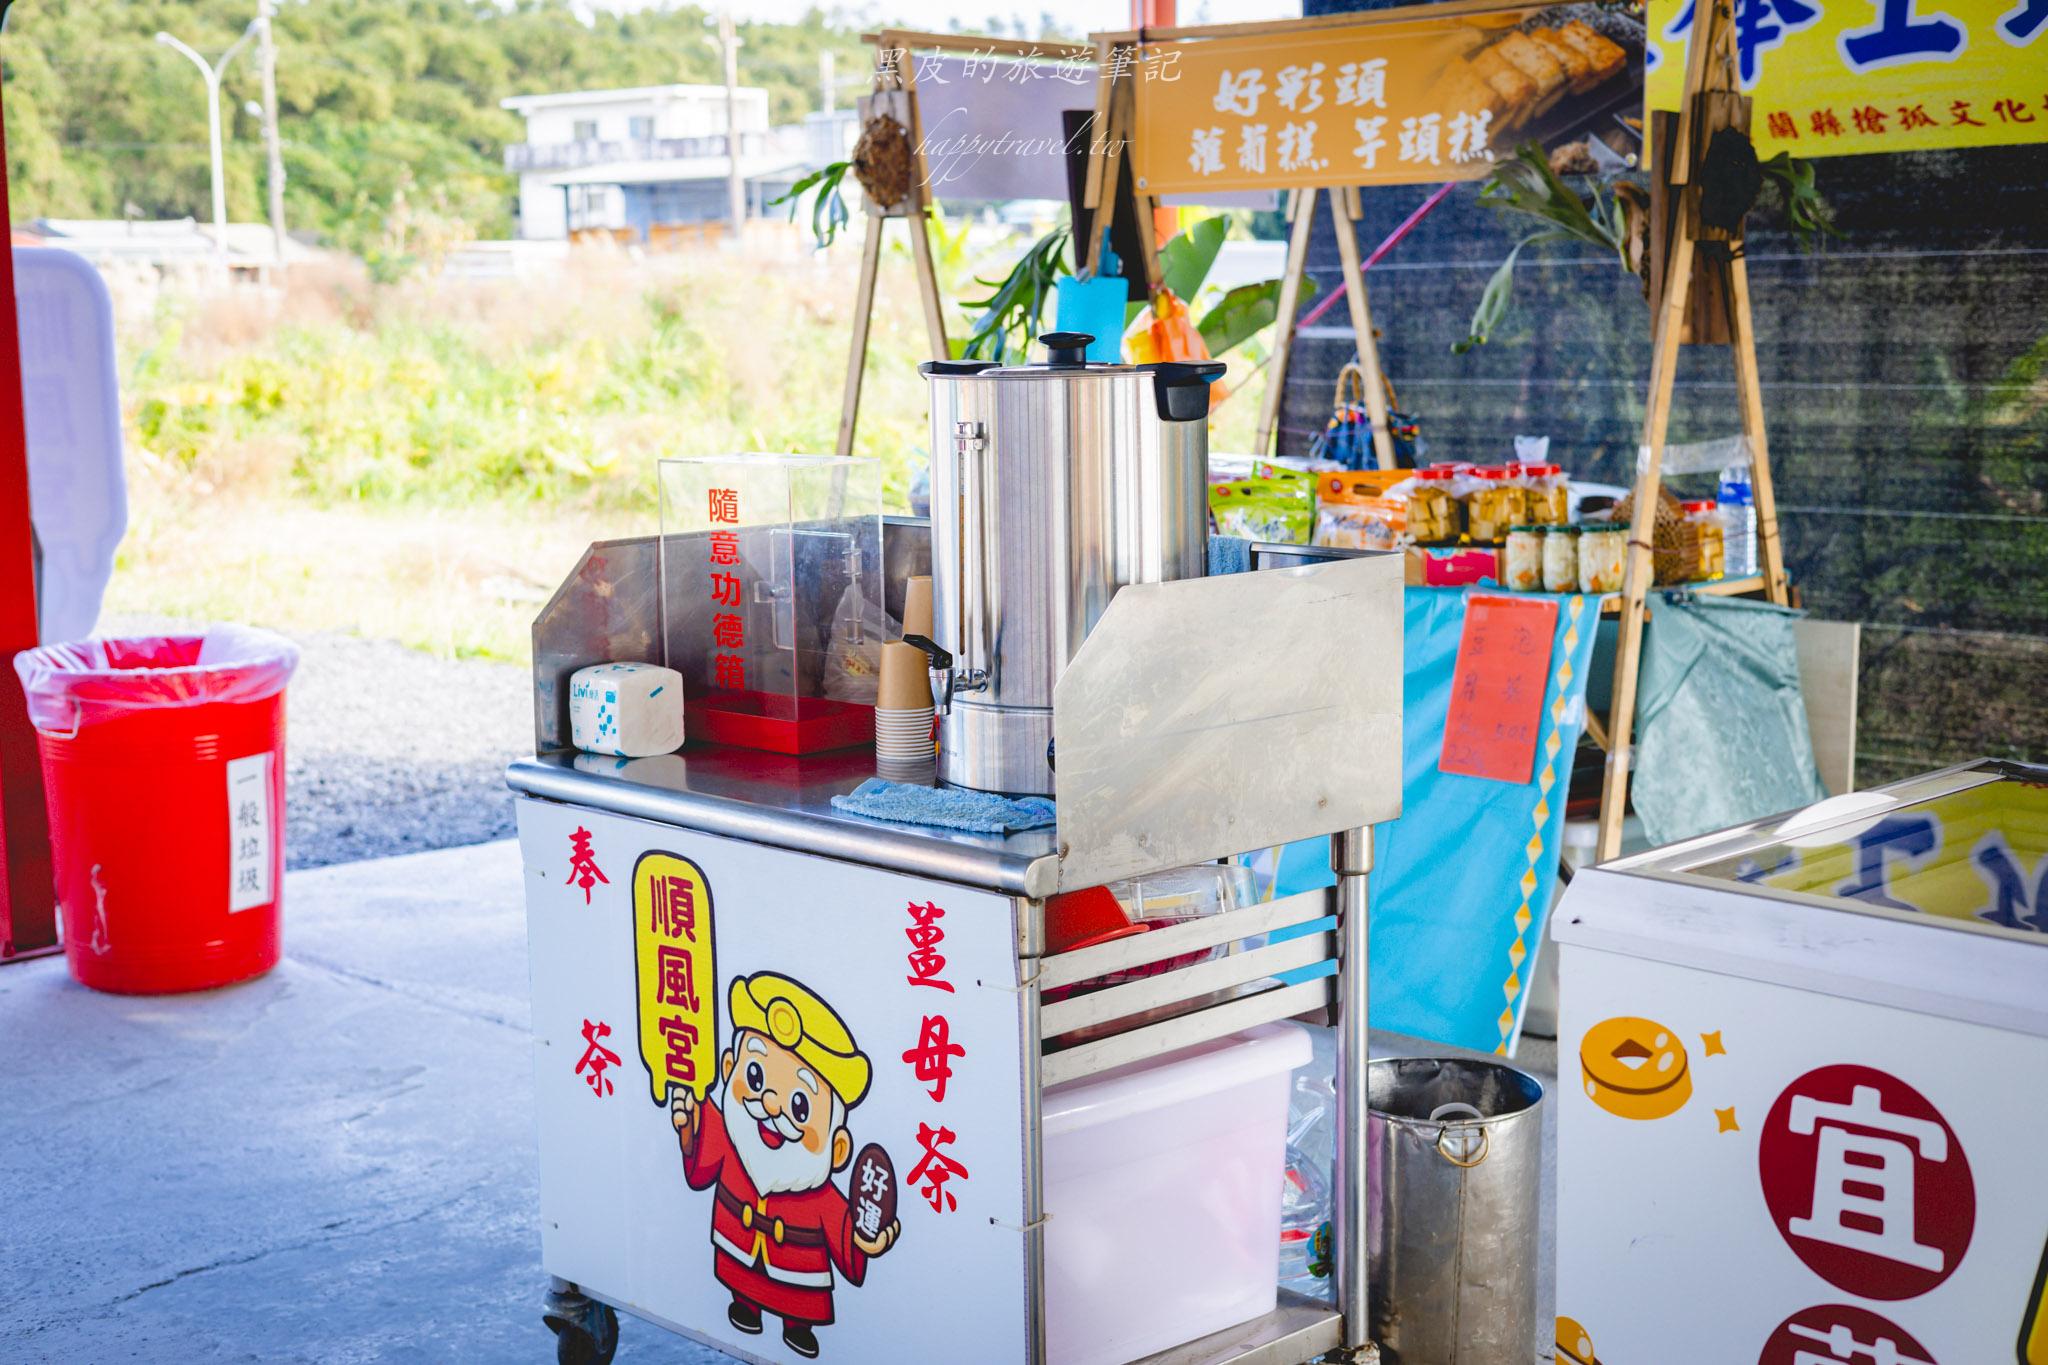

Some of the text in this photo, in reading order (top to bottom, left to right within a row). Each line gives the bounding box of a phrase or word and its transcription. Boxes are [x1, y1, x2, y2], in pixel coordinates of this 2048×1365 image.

[1213, 58, 1388, 116] 好彩頭
[1353, 108, 1494, 169] 芋頭糕
[1749, 95, 2048, 142] 蘭縣搶孤文化
[708, 487, 745, 690] 隨意功德箱
[237, 774, 260, 893] 一般垃圾
[565, 825, 622, 1098] 奉茶
[650, 875, 700, 1082] 順風宮
[902, 900, 969, 1214] 薑母茶
[856, 1157, 889, 1239] 好運
